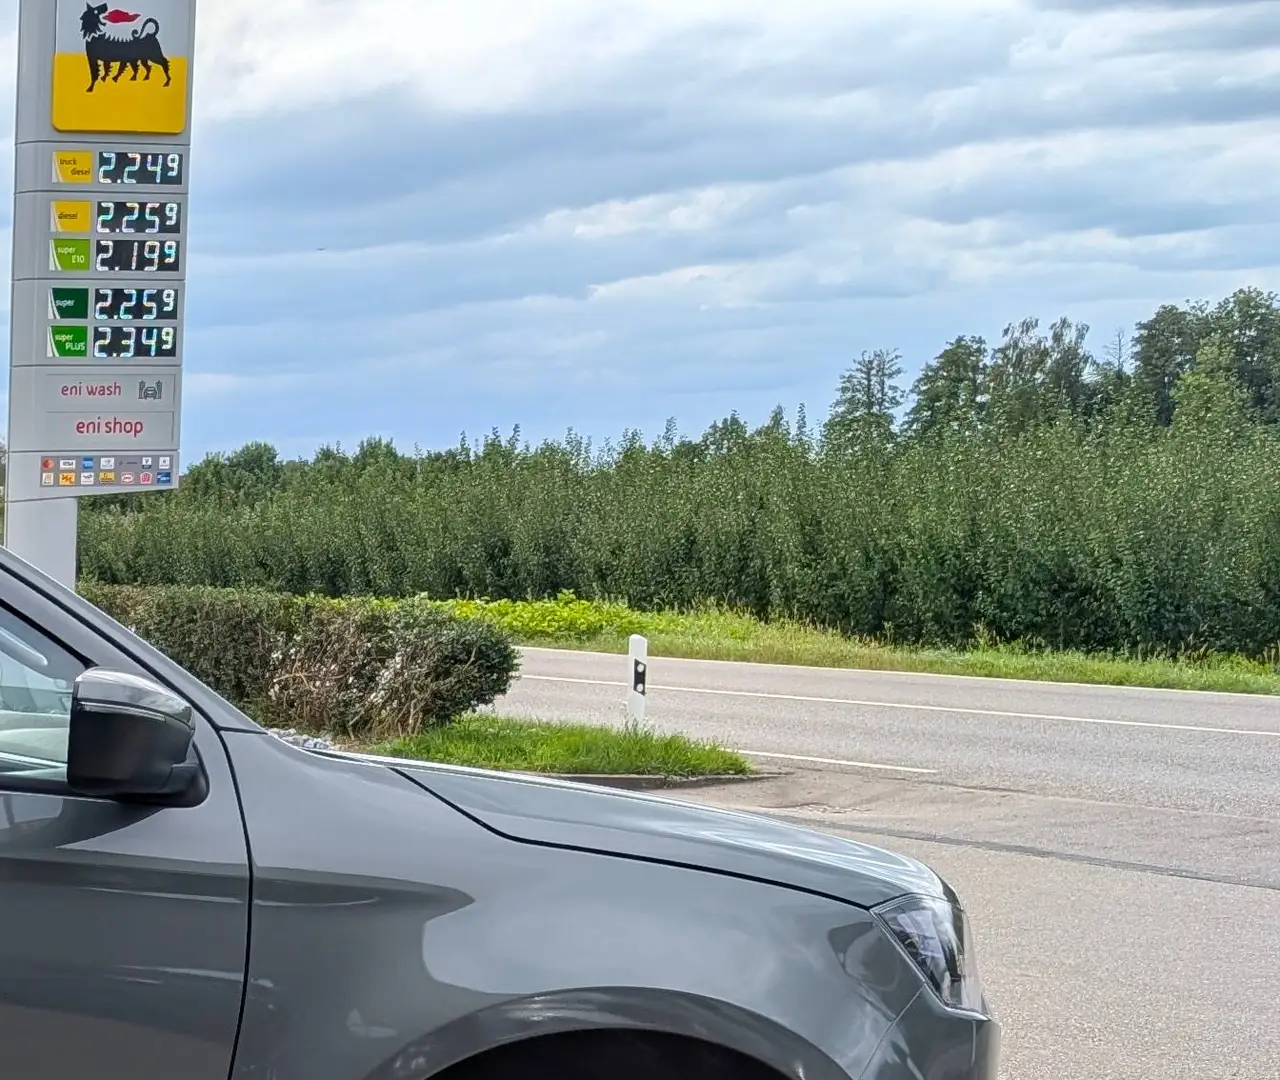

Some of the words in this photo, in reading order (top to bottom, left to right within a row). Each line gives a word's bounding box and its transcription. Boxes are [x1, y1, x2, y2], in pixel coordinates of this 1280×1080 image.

[98, 152, 180, 184] 2.249
[57, 212, 78, 220] diesel
[96, 202, 178, 233] 2.259
[57, 246, 76, 254] super
[96, 240, 177, 271] 2.199
[71, 255, 85, 264] E10
[55, 299, 75, 307] super
[95, 289, 175, 320] 2.259
[65, 342, 85, 350] PLUS
[93, 327, 174, 358] 2.349
[61, 382, 83, 396] eni
[86, 382, 121, 396] wash
[75, 417, 102, 434] eni
[104, 417, 144, 437] shop
